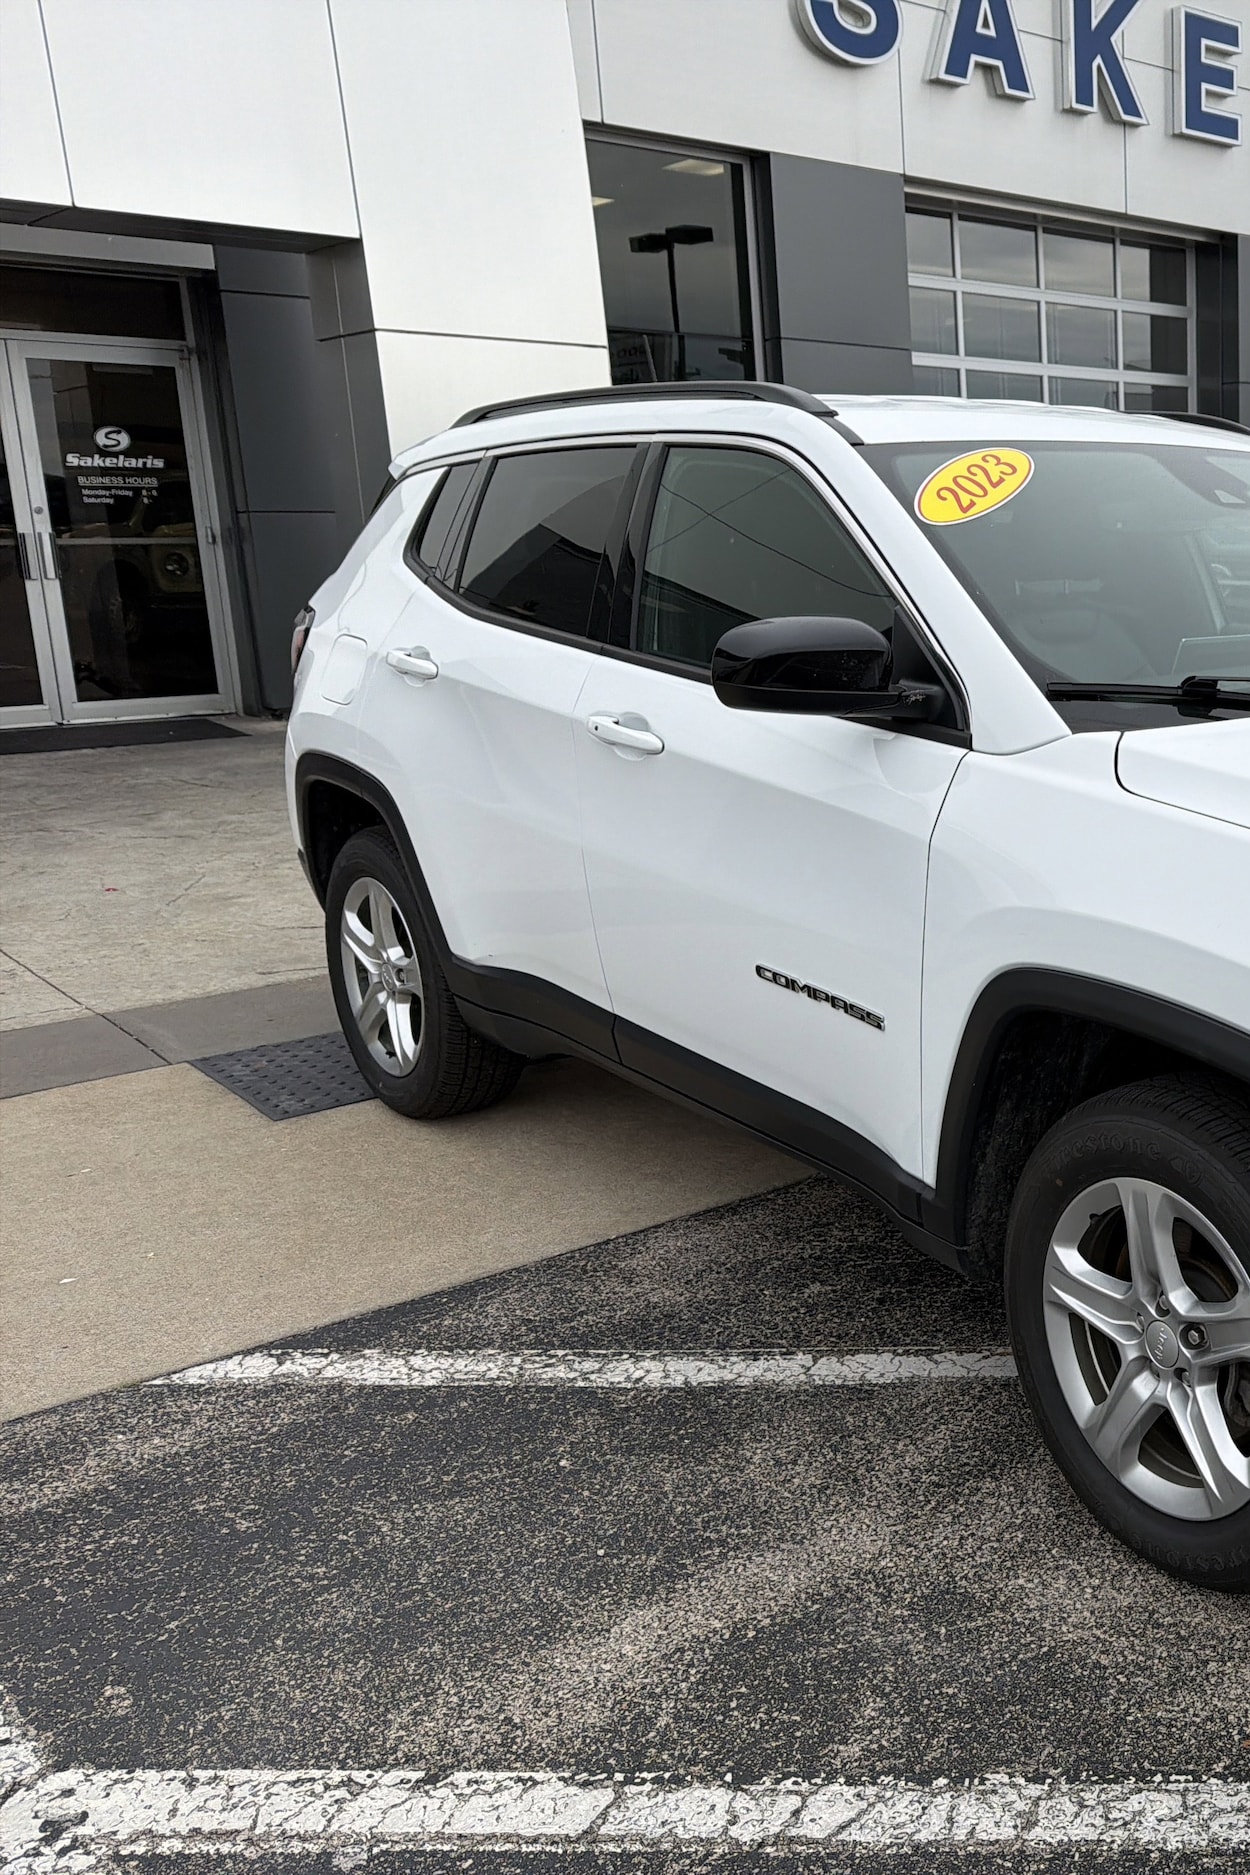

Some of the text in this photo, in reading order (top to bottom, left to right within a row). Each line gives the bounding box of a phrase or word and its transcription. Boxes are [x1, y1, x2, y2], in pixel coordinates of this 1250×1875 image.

[65, 452, 165, 468] Sakelaris
[77, 475, 158, 486] BUSINESS HOURS
[936, 454, 1018, 514] 2023
[82, 496, 115, 504] Saturday
[755, 963, 886, 1032] COMPASS
